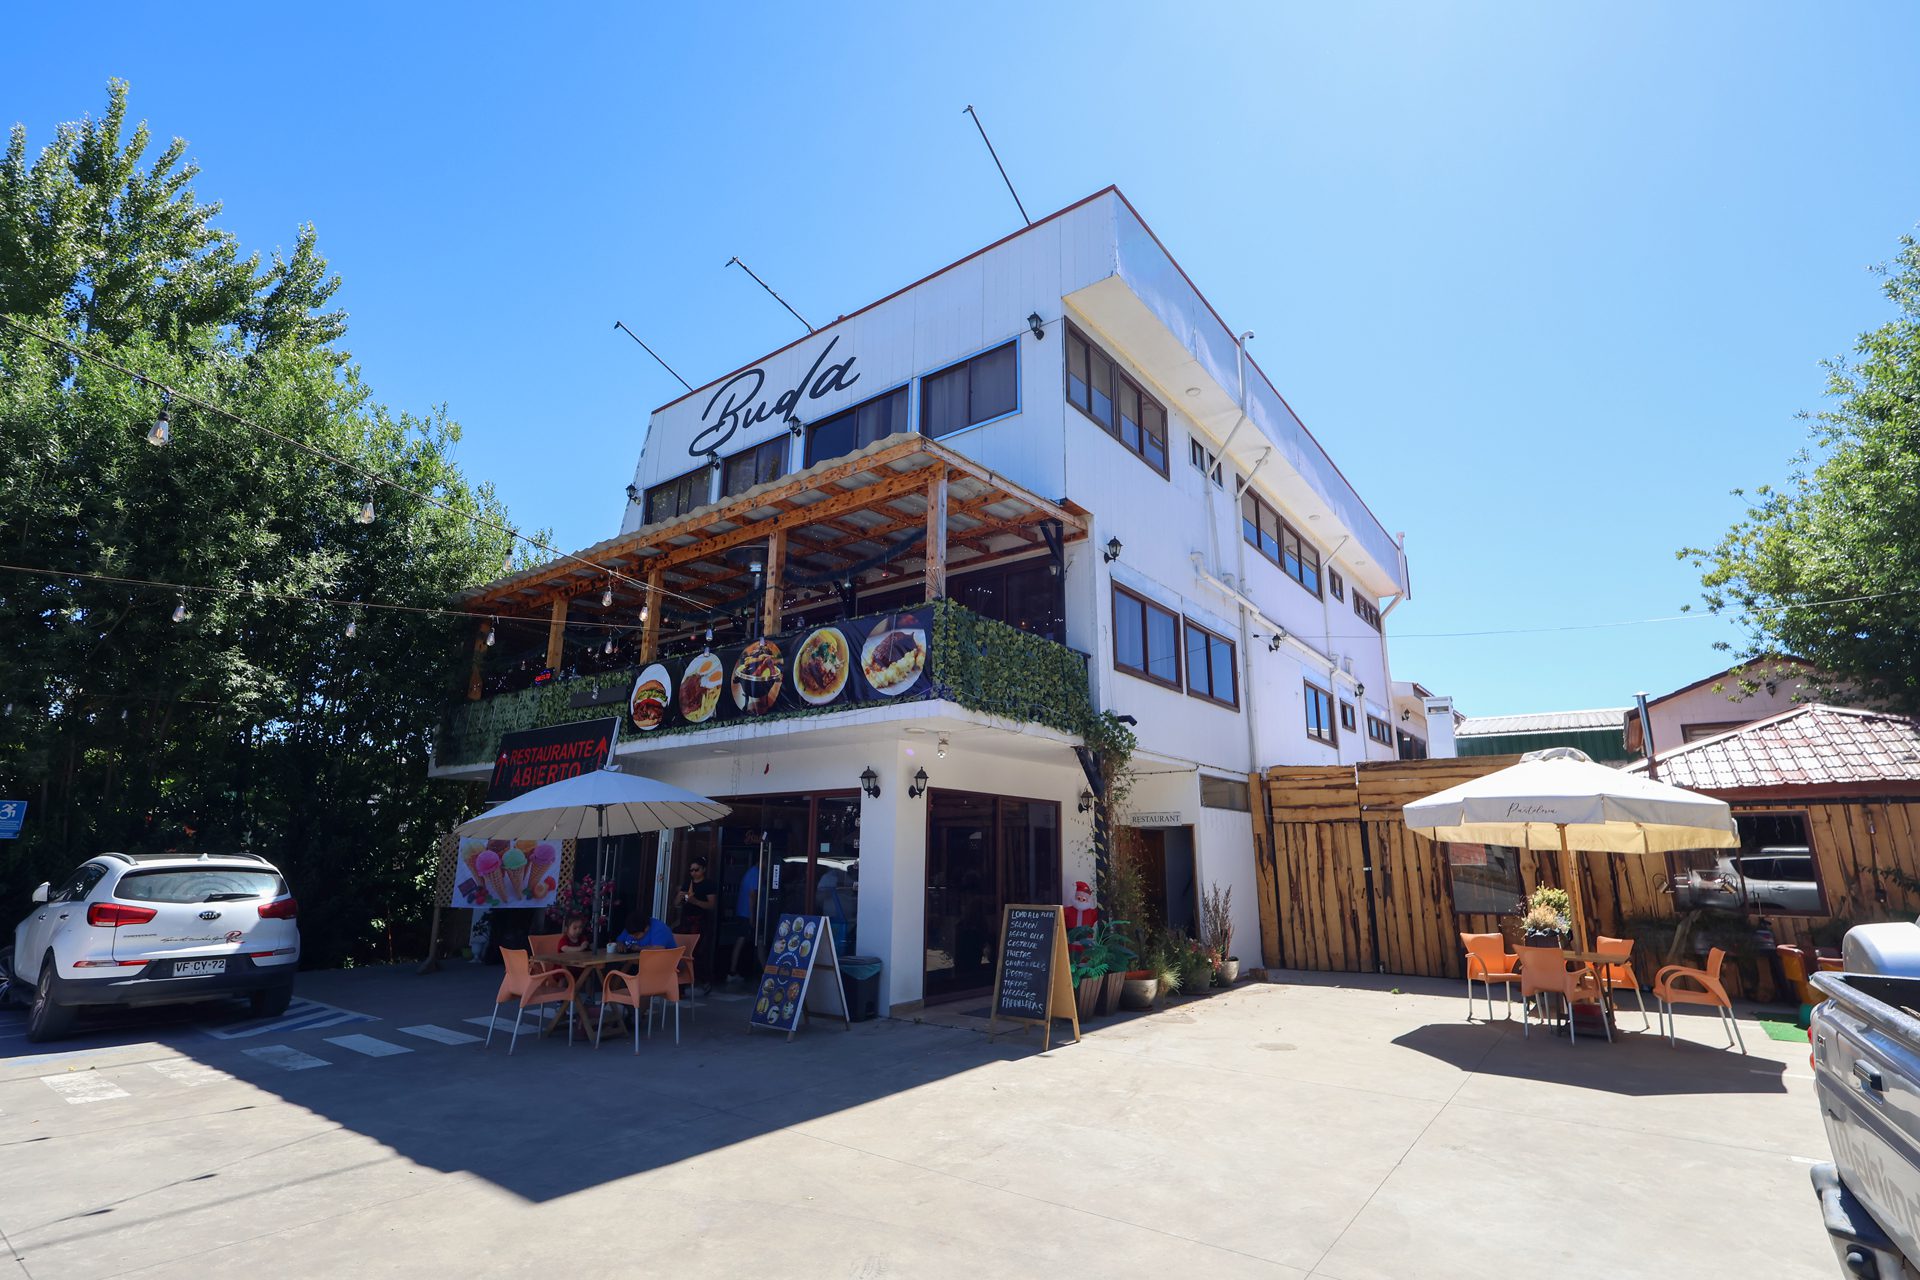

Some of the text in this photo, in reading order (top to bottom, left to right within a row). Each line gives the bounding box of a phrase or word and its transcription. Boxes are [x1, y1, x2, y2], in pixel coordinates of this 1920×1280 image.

[688, 335, 861, 457] Buda
[510, 740, 594, 766] RESTAURANTE
[511, 762, 581, 787] ABIERTO
[1132, 815, 1180, 823] RESTAURANT
[200, 911, 219, 920] KIA
